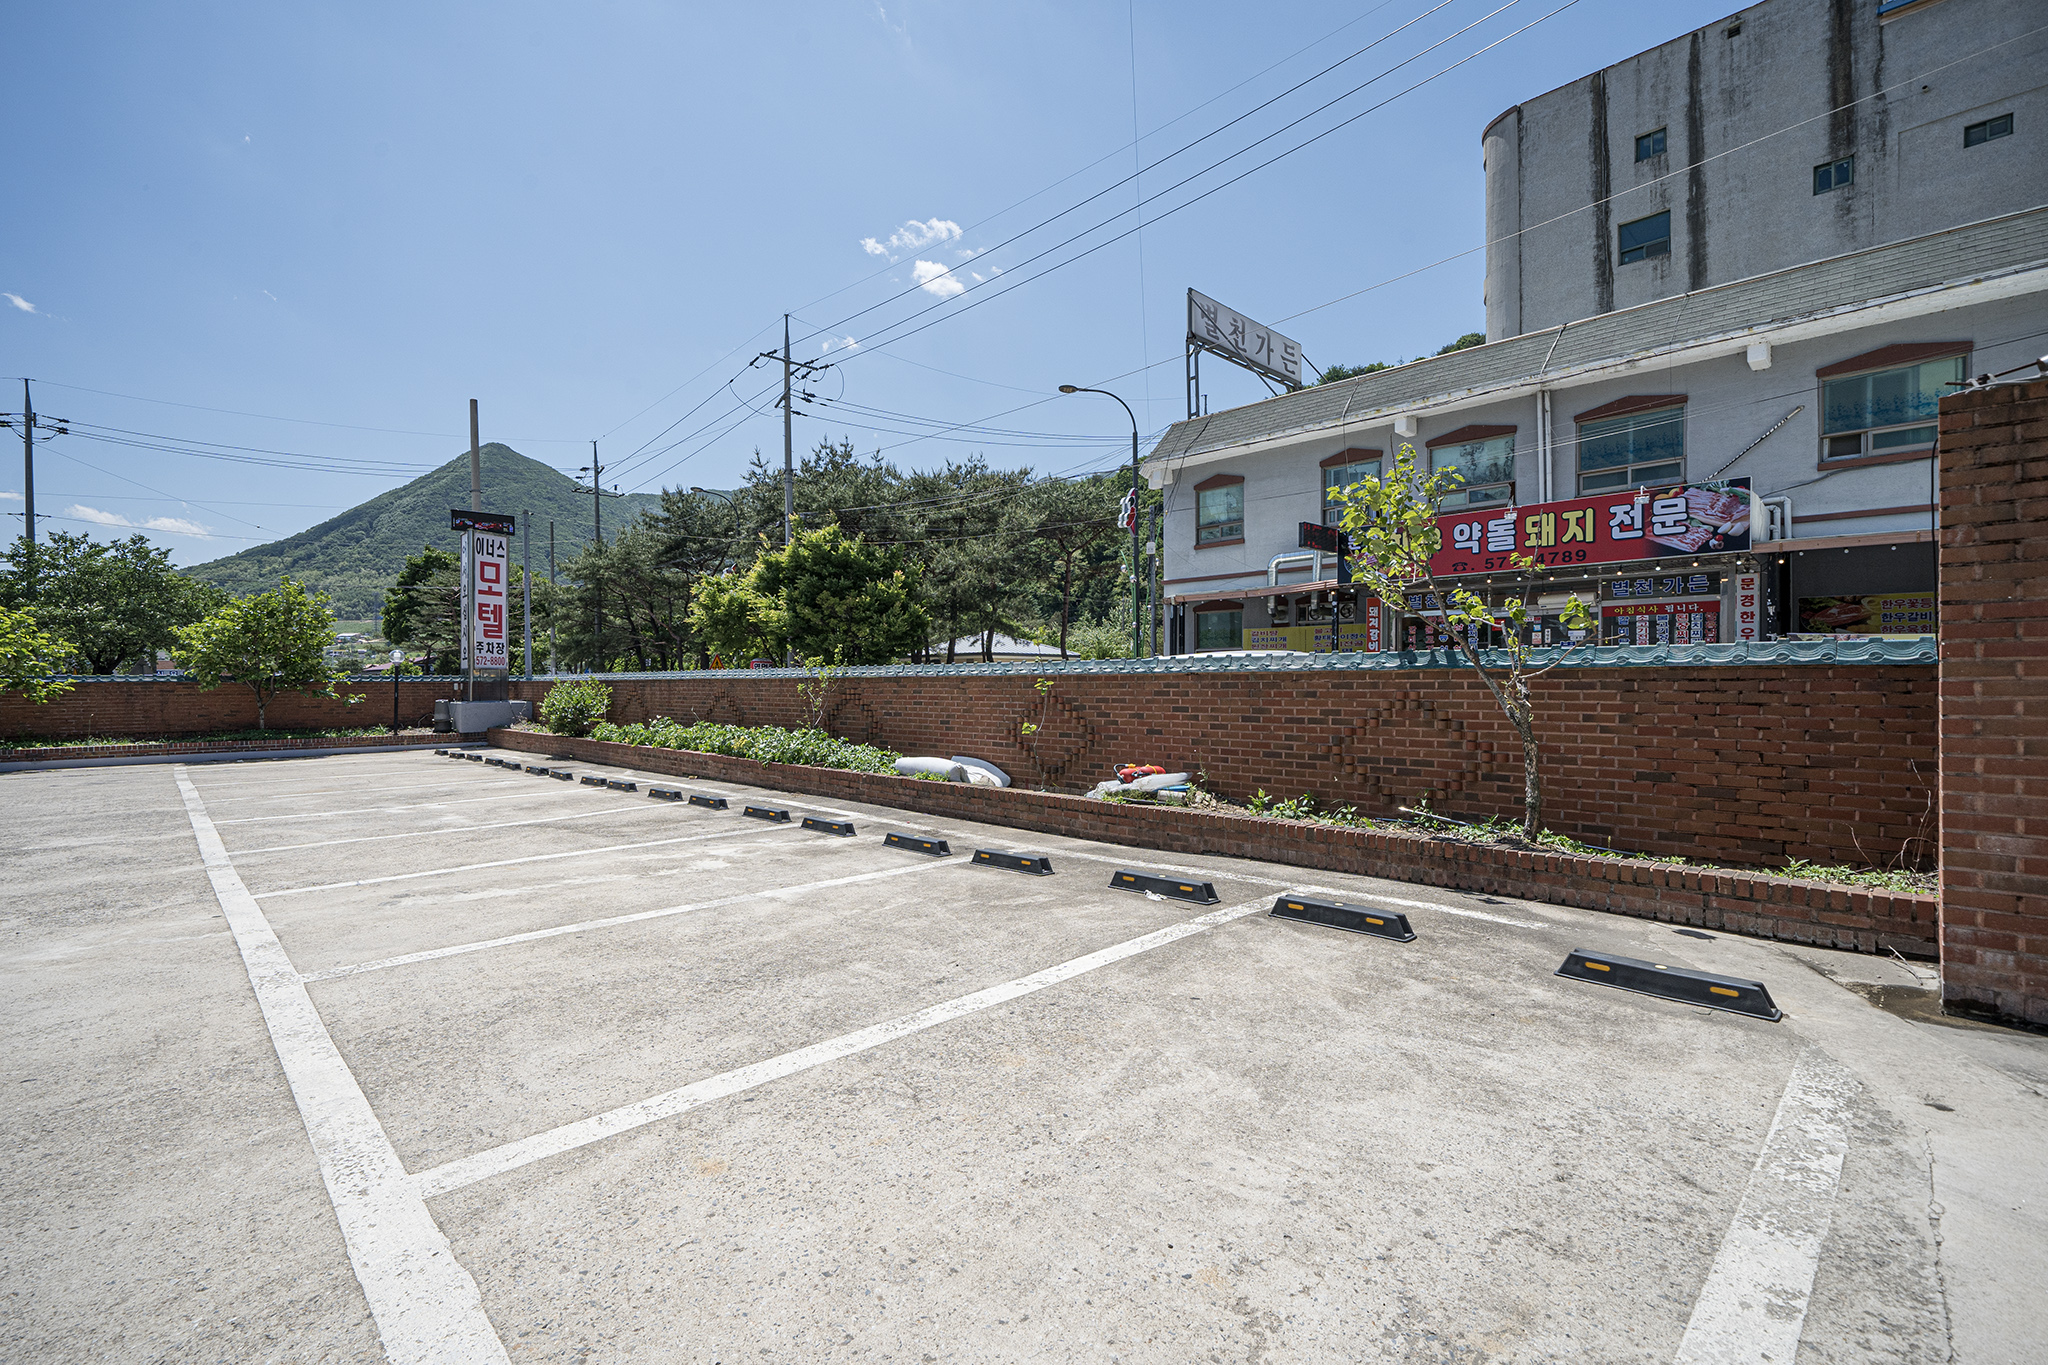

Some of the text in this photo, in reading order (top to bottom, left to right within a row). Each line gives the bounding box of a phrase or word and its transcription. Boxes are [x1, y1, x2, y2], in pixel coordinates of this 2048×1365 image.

[1199, 302, 1298, 375] 별천가든
[1609, 497, 1688, 539] 전문
[475, 537, 505, 558] 이너스
[1484, 549, 1587, 569] 574789
[1611, 574, 1710, 597] 별천 가든
[477, 560, 503, 640] 모텔
[1614, 605, 1659, 615] 아침식사
[1740, 577, 1756, 641] 문경한우
[1368, 606, 1380, 651] 돼지갈비
[1656, 614, 1669, 645] 불고기정
[475, 641, 505, 655] 주차장
[475, 656, 506, 667] 572-8800
